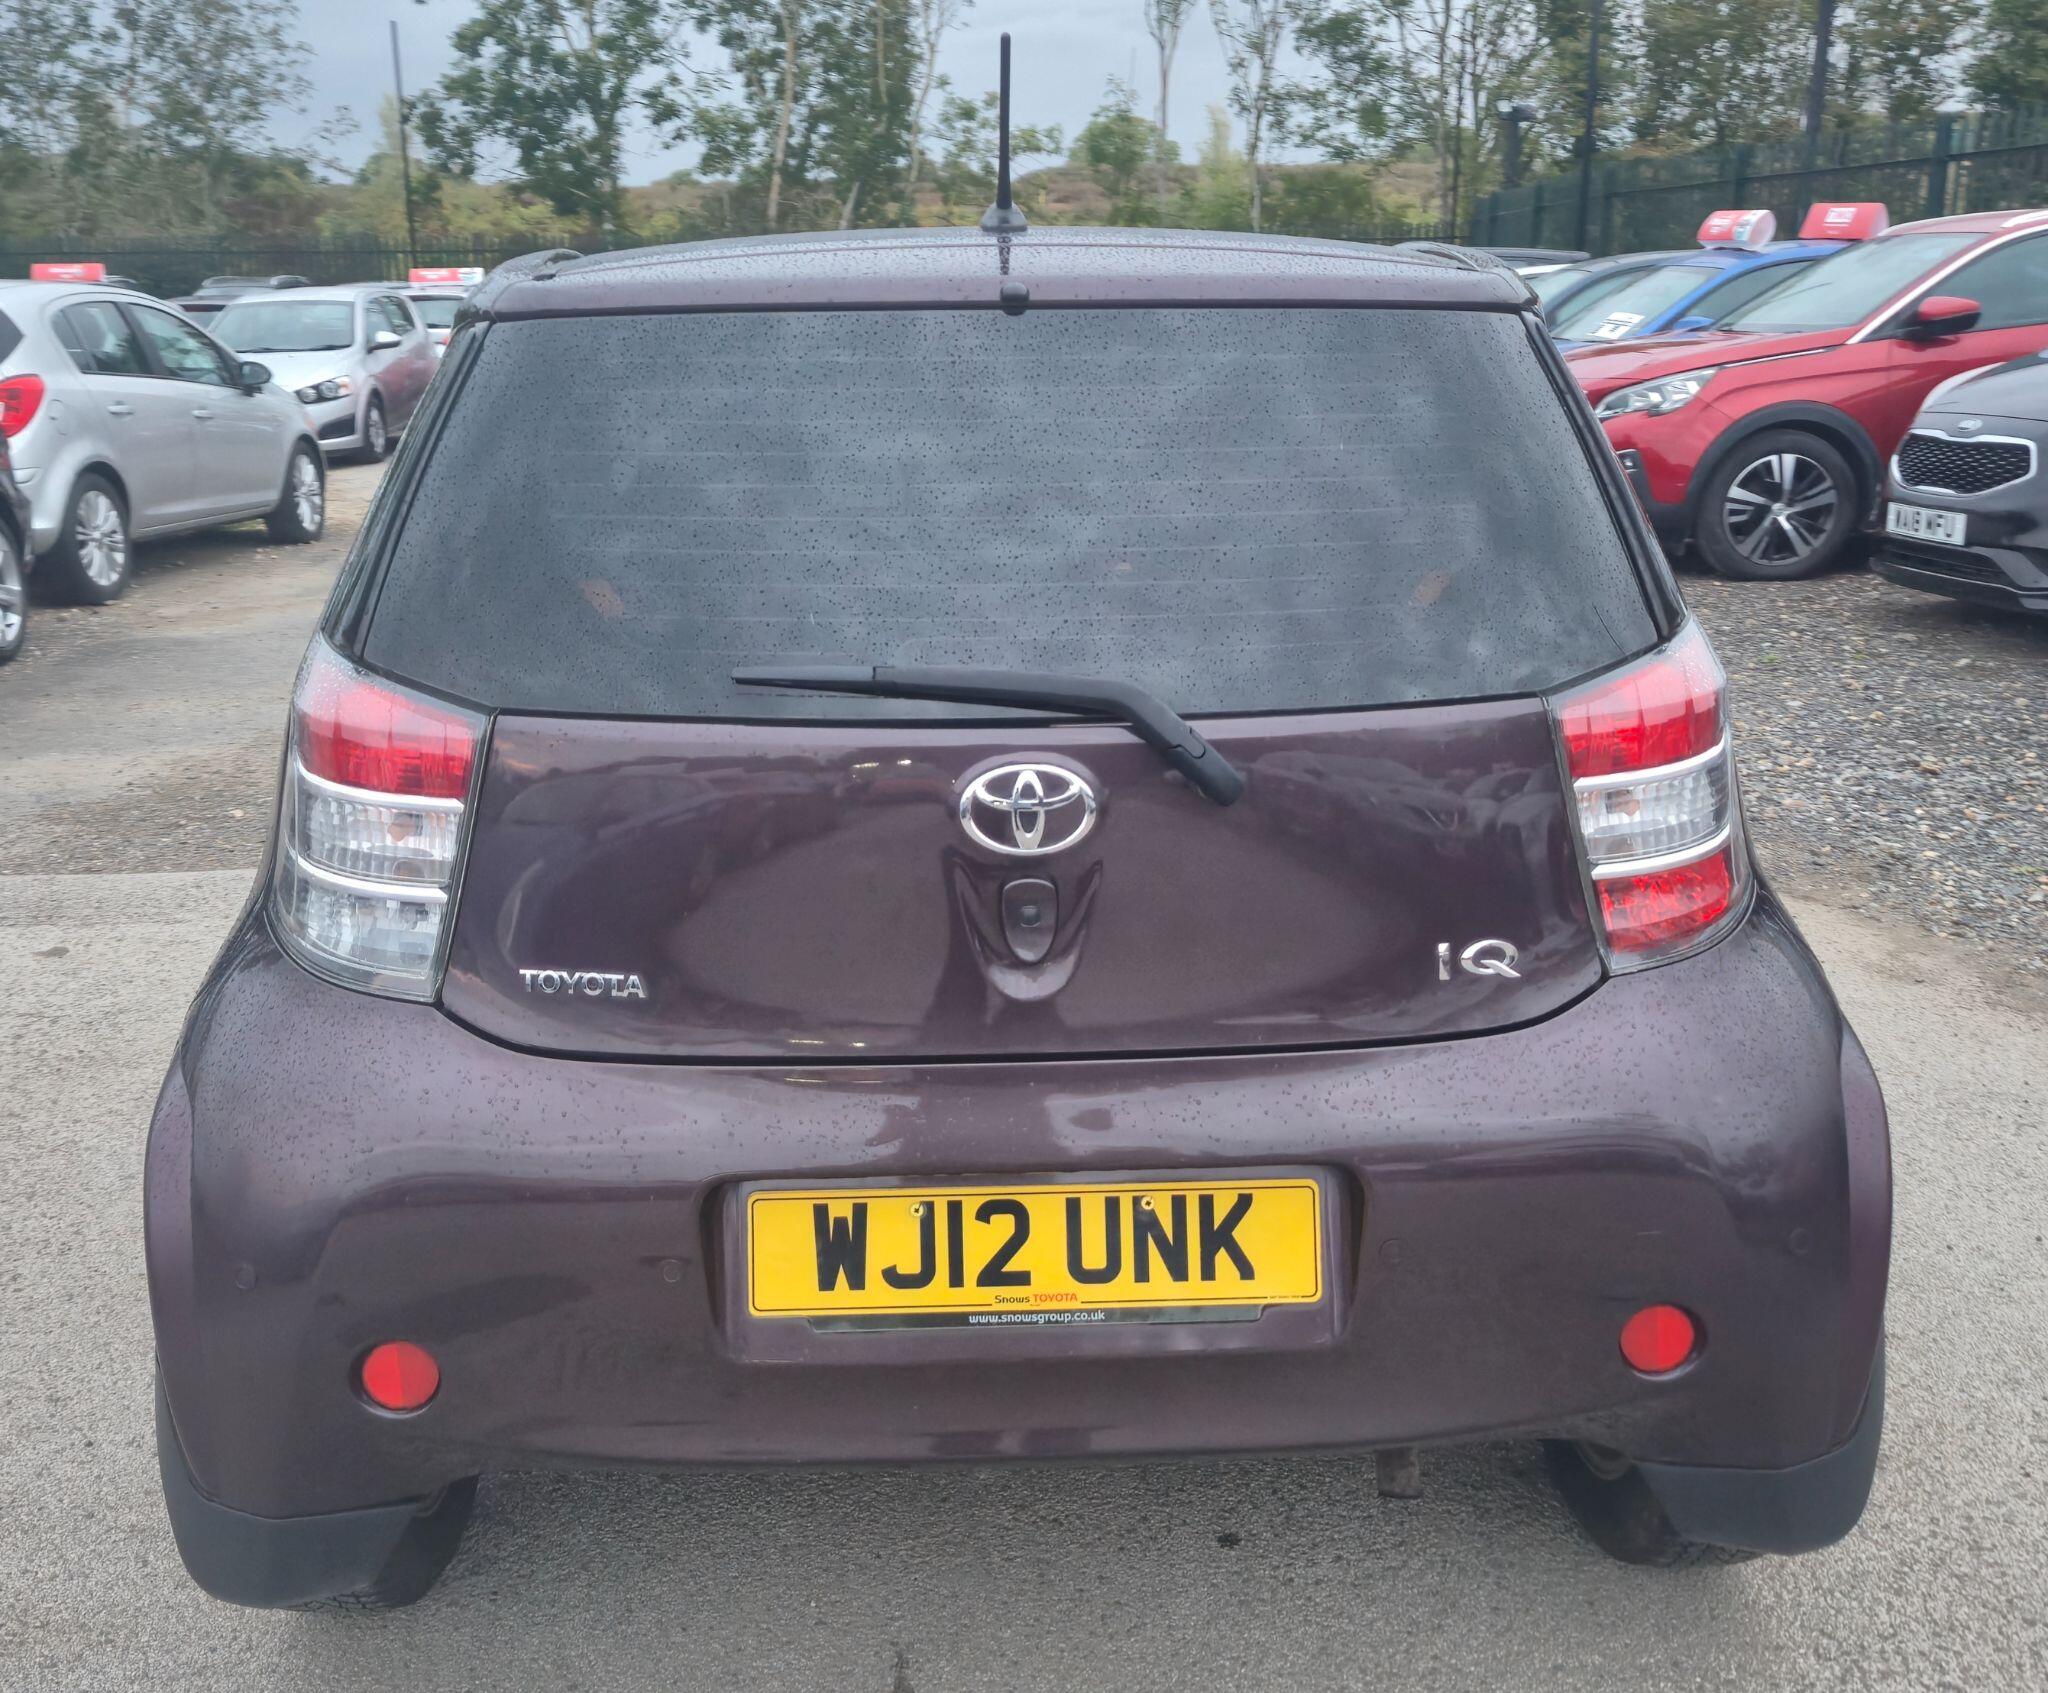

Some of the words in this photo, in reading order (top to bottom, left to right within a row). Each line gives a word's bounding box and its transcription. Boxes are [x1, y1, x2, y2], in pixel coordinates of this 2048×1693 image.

[518, 968, 647, 999] TOYOTA
[812, 1198, 1032, 1292] WJ12
[1065, 1192, 1256, 1285] UNK
[994, 1294, 1031, 1304] Snows
[1032, 1292, 1079, 1303] TOYOTA
[968, 1309, 1106, 1324] www.snowsgroup.co.uk
